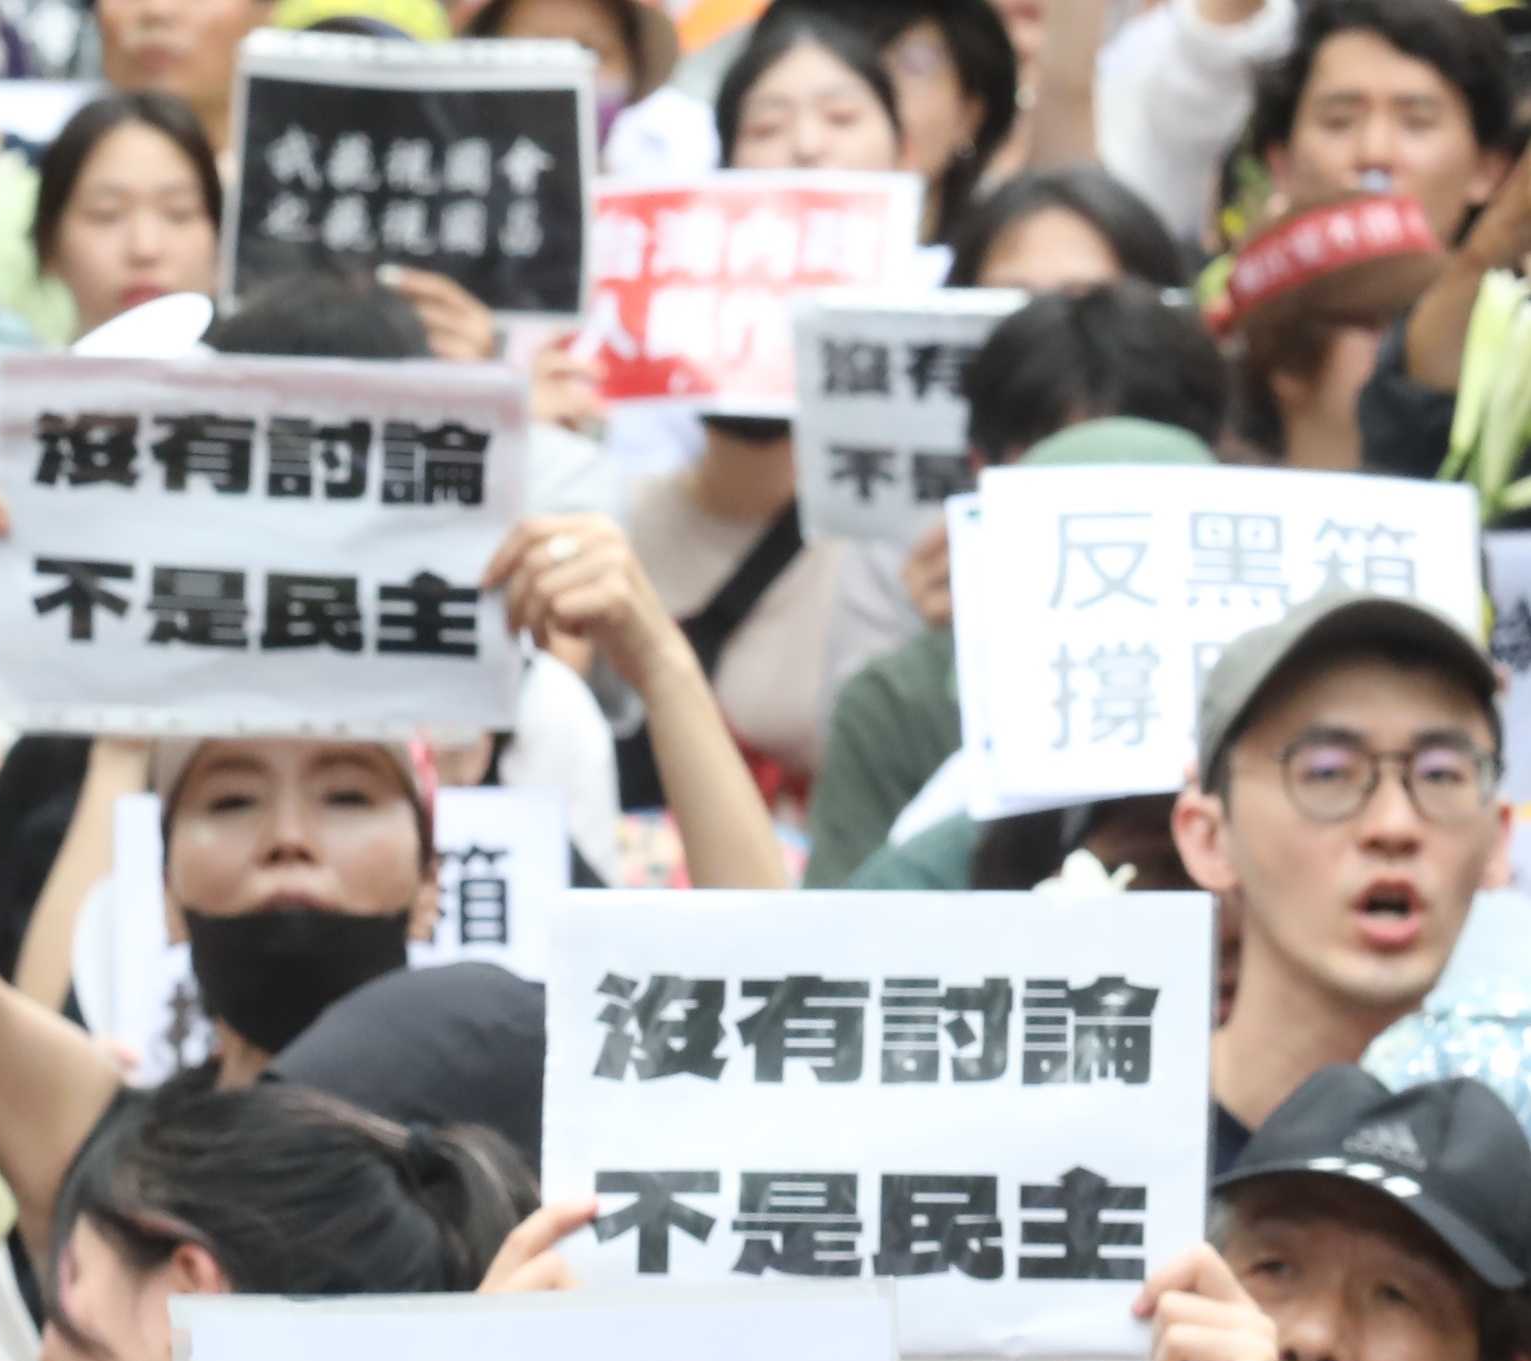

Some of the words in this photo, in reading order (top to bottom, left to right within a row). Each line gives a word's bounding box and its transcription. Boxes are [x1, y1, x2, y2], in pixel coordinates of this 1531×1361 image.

[33, 411, 492, 507] 沒有討論
[33, 556, 482, 658] 不是民主
[1049, 510, 1418, 612] 反黑箱
[593, 970, 1161, 1087] 沒有討論
[593, 1165, 1149, 1282] 不是民主
